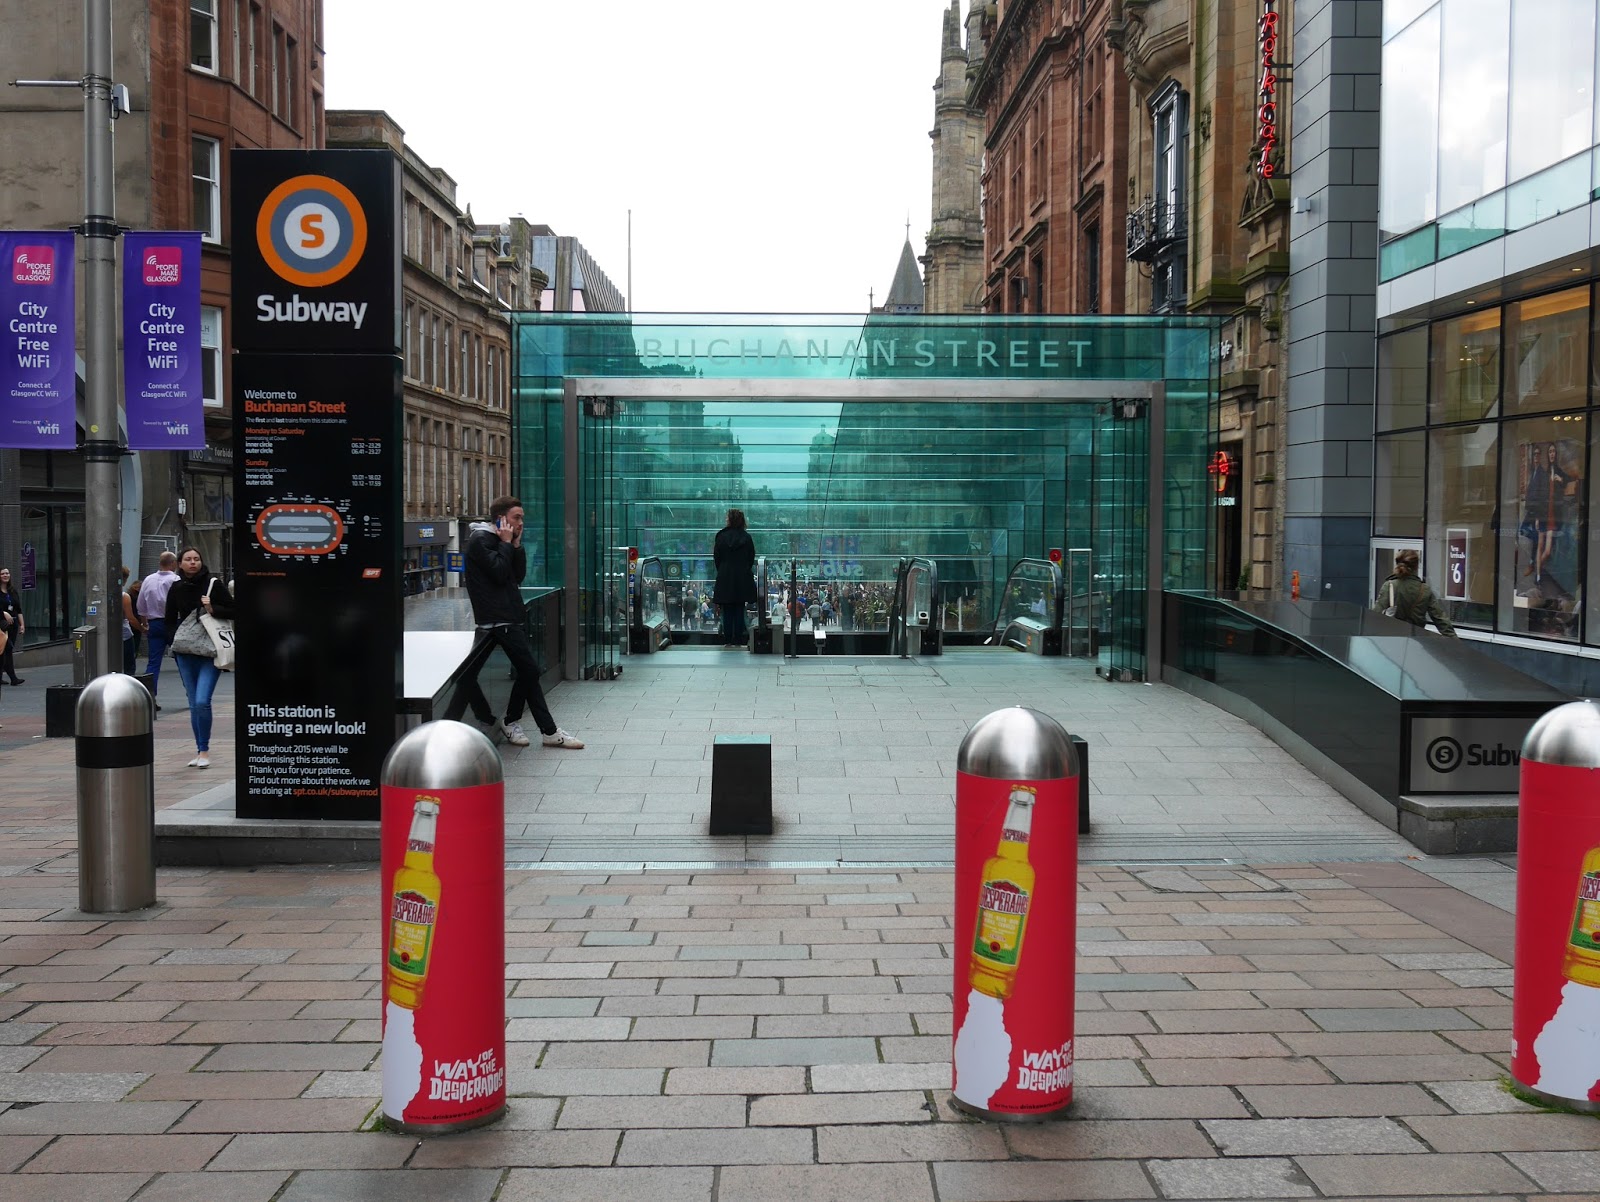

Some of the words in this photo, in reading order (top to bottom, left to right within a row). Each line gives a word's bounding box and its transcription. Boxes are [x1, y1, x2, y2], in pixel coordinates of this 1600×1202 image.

[1258, 102, 1277, 179] Cafe
[300, 213, 325, 249] S
[19, 302, 48, 318] City
[149, 303, 176, 319] City
[257, 294, 368, 329] Subway
[9, 319, 58, 333] Centre
[140, 321, 185, 334] Centre
[18, 337, 50, 350] Free
[148, 338, 177, 350] Free
[642, 338, 896, 368] BUCHANAN
[914, 339, 1092, 368] STREET
[18, 354, 50, 368] WiFi
[148, 355, 178, 369] WiFi
[10, 390, 44, 398] GlasgowCC
[141, 391, 173, 399] GlasgowCC
[244, 390, 286, 399] Welcome
[287, 391, 297, 399] to
[245, 400, 306, 413] Buchanan
[308, 401, 346, 413] Street
[37, 424, 59, 435] wifi
[167, 424, 189, 435] wifi
[245, 427, 270, 435] Monday
[278, 427, 305, 436] Saturday
[245, 459, 269, 467] Sunday
[247, 704, 275, 717] This
[278, 705, 322, 718] station
[325, 705, 336, 718] is
[248, 721, 293, 737] getting
[295, 725, 303, 734] a
[305, 724, 332, 734] new
[334, 721, 366, 735] look!
[248, 744, 292, 754] Throughout
[293, 745, 311, 753] 2015
[324, 745, 338, 753] will
[338, 745, 349, 754] be
[248, 754, 295, 765] modernising
[296, 755, 311, 764] this
[311, 756, 340, 764] station.
[248, 765, 272, 774] Thank
[273, 767, 288, 775] you
[288, 766, 300, 774] for
[300, 767, 317, 776] your
[318, 766, 352, 776] patience.
[248, 775, 265, 784] Find
[301, 776, 324, 785] about
[325, 777, 339, 785] the
[339, 777, 359, 785] work
[261, 786, 283, 796] doing
[284, 787, 292, 795] at
[293, 788, 378, 797] spt.co.uk/subwaymod
[1023, 1042, 1063, 1070] WAY
[435, 1054, 482, 1080] WAY
[482, 1048, 493, 1061] OF
[480, 1058, 496, 1075] THE
